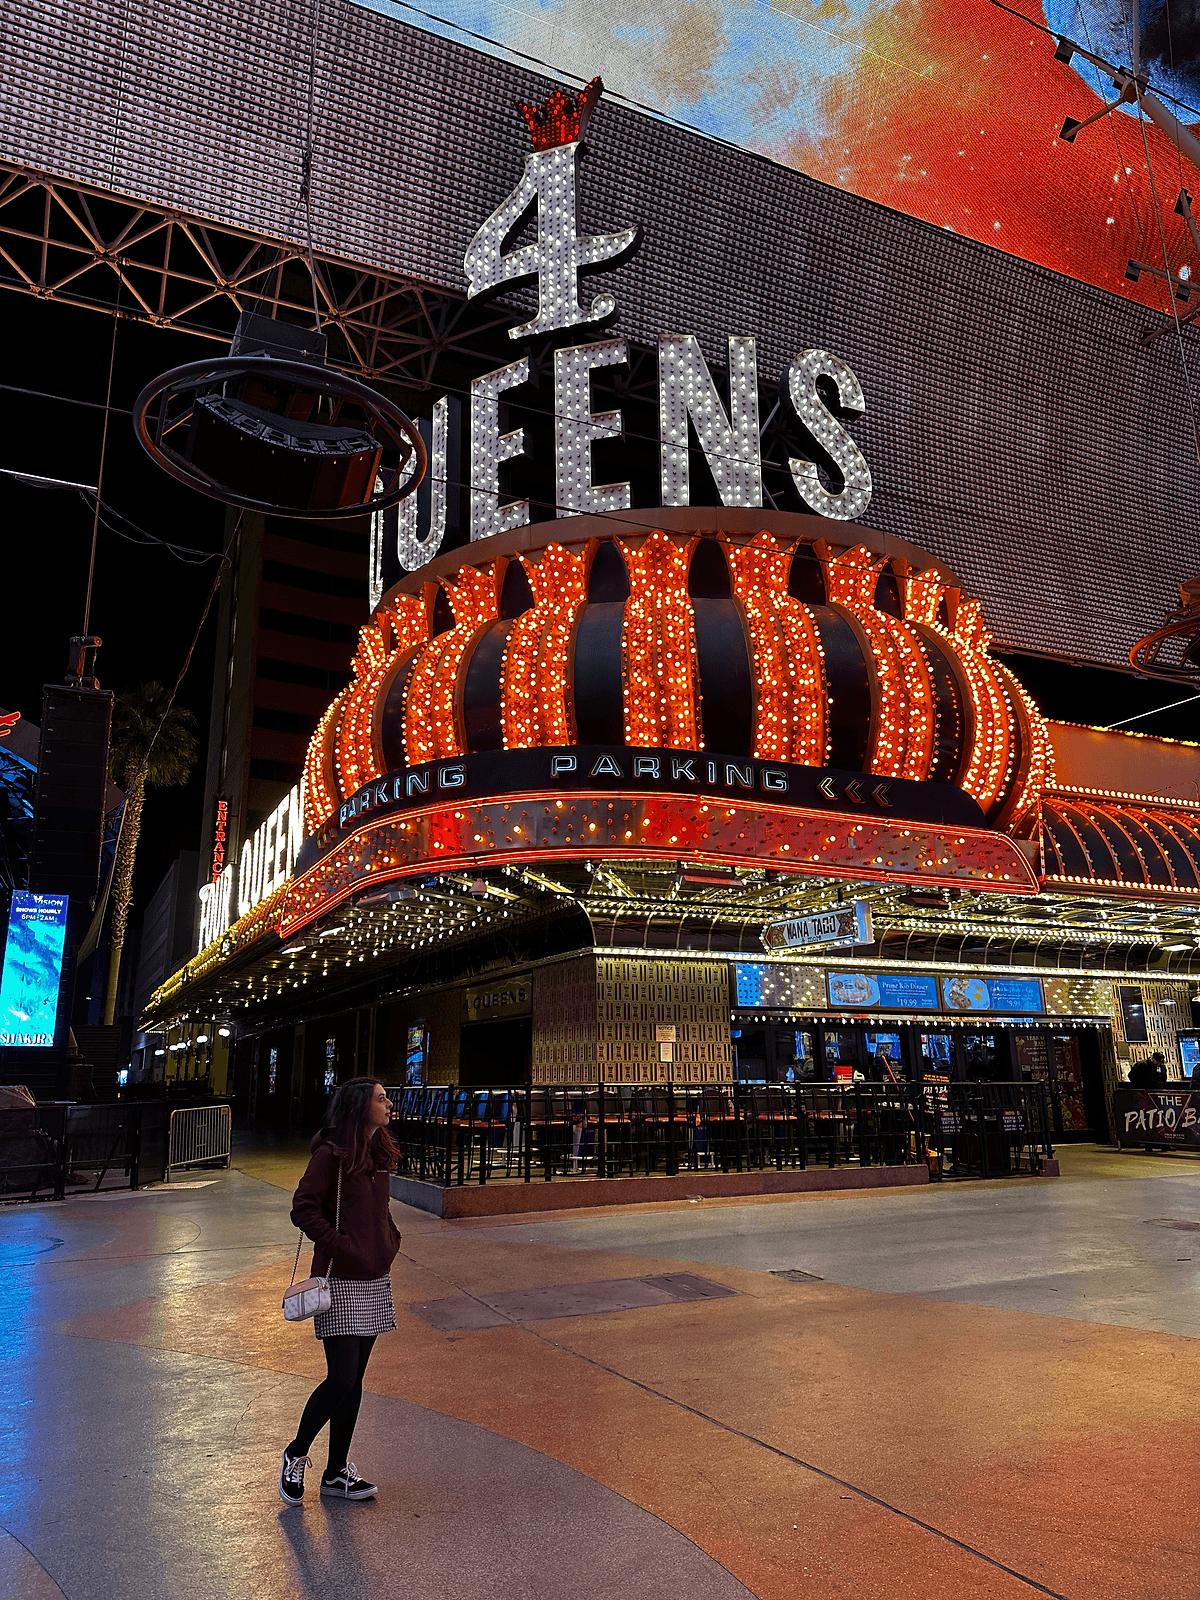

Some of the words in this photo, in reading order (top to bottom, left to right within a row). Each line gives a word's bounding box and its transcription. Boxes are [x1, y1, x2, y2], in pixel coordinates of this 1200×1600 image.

[463, 142, 640, 340] 4
[550, 754, 789, 791] PARKING
[339, 764, 467, 829] PARKING
[473, 987, 526, 1010] QUEENS
[0, 1033, 54, 1045] SHAKIRA
[1157, 1095, 1183, 1107] THE
[1124, 1107, 1176, 1132] PATIO
